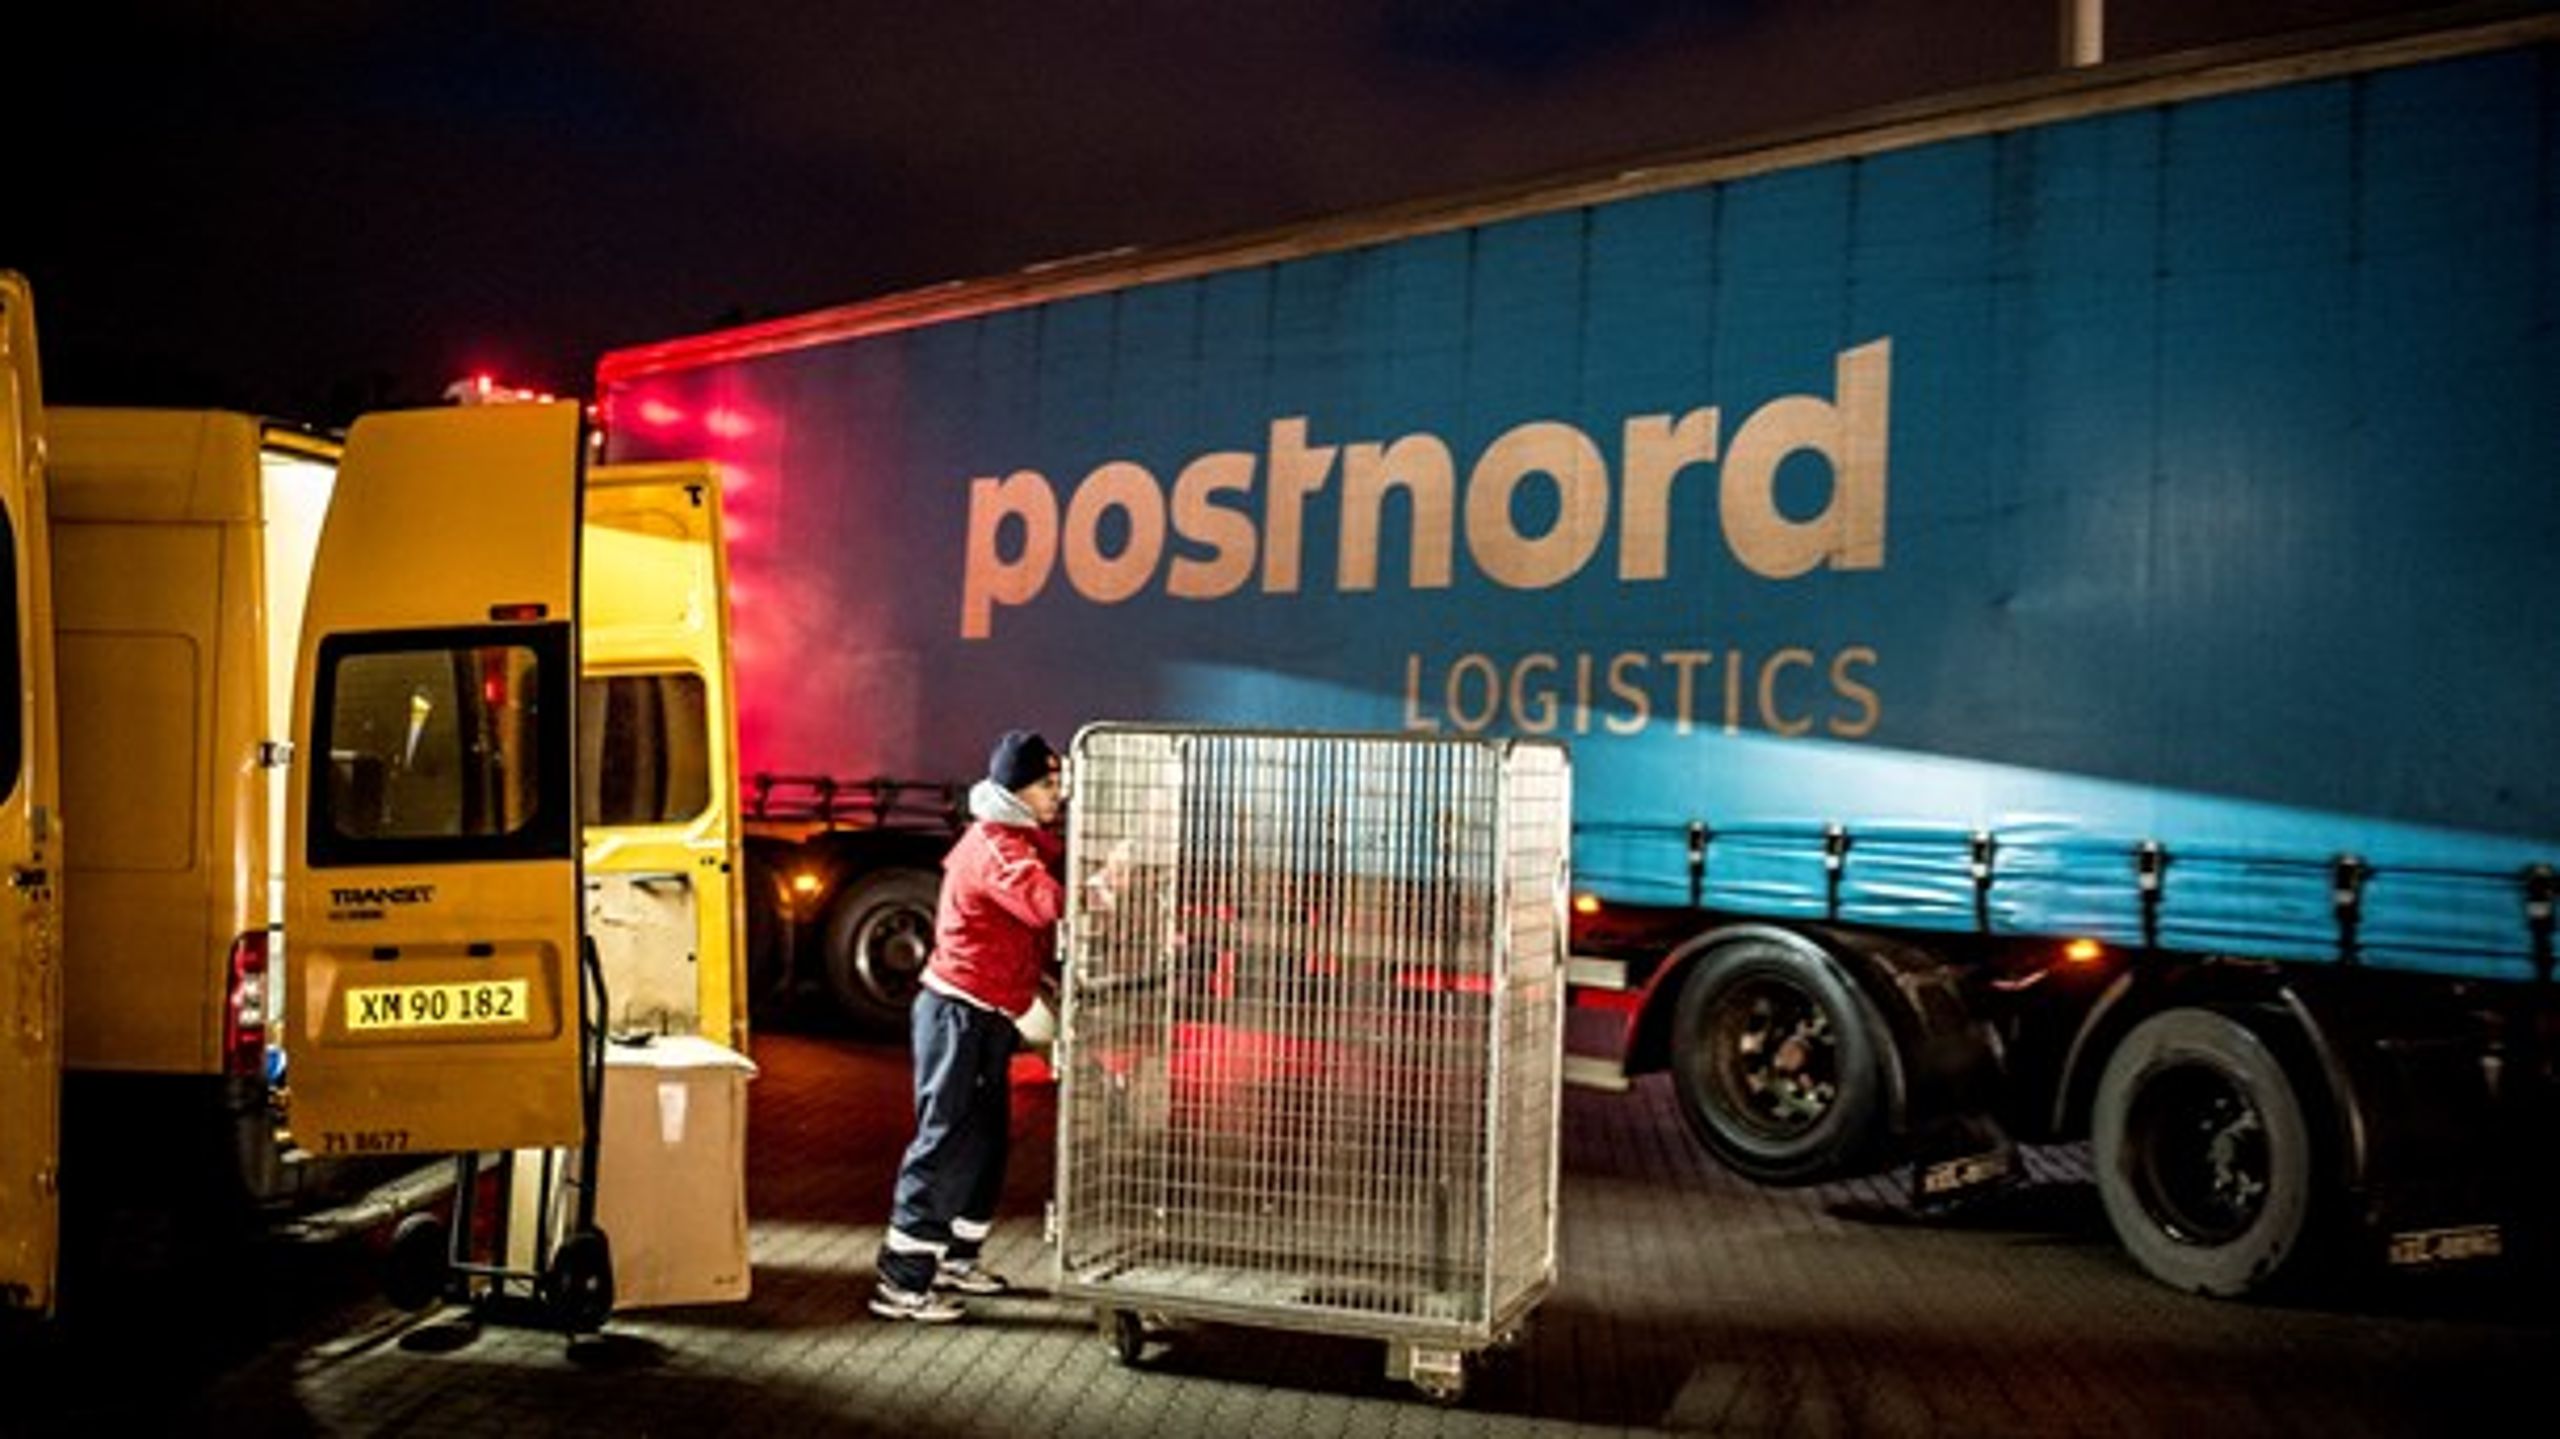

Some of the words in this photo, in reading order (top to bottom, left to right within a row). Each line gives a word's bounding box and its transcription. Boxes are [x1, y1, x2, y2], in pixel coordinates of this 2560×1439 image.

[960, 336, 1891, 638] postnord
[1404, 645, 1882, 738] LOGISTICS
[360, 993, 403, 1024] XM
[411, 990, 447, 1020] 90
[460, 986, 513, 1018] 182
